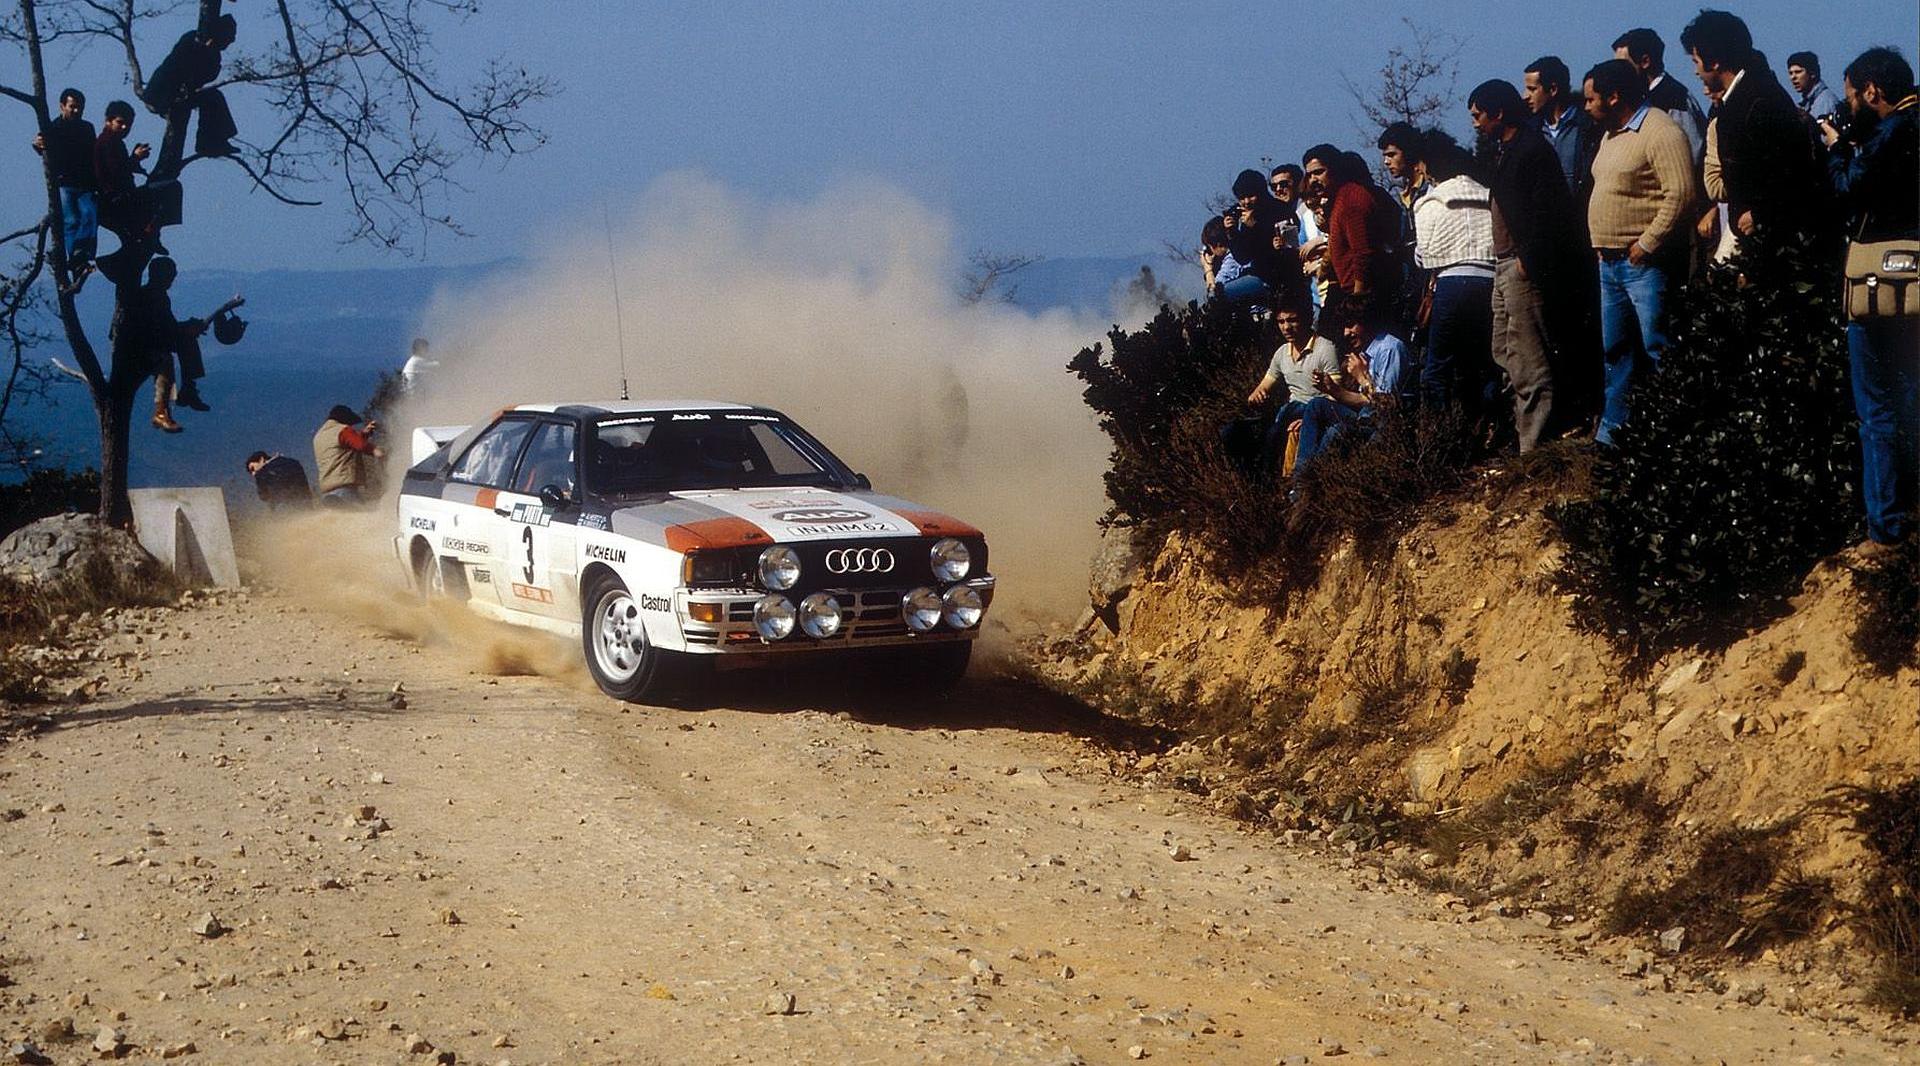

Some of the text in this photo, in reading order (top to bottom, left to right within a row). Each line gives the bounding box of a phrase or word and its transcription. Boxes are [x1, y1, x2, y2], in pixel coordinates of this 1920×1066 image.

[410, 516, 436, 531] MICHELIN
[864, 522, 887, 532] 62
[522, 525, 535, 585] 3
[585, 543, 627, 563] MICHELIN
[641, 593, 672, 613] Castrol
